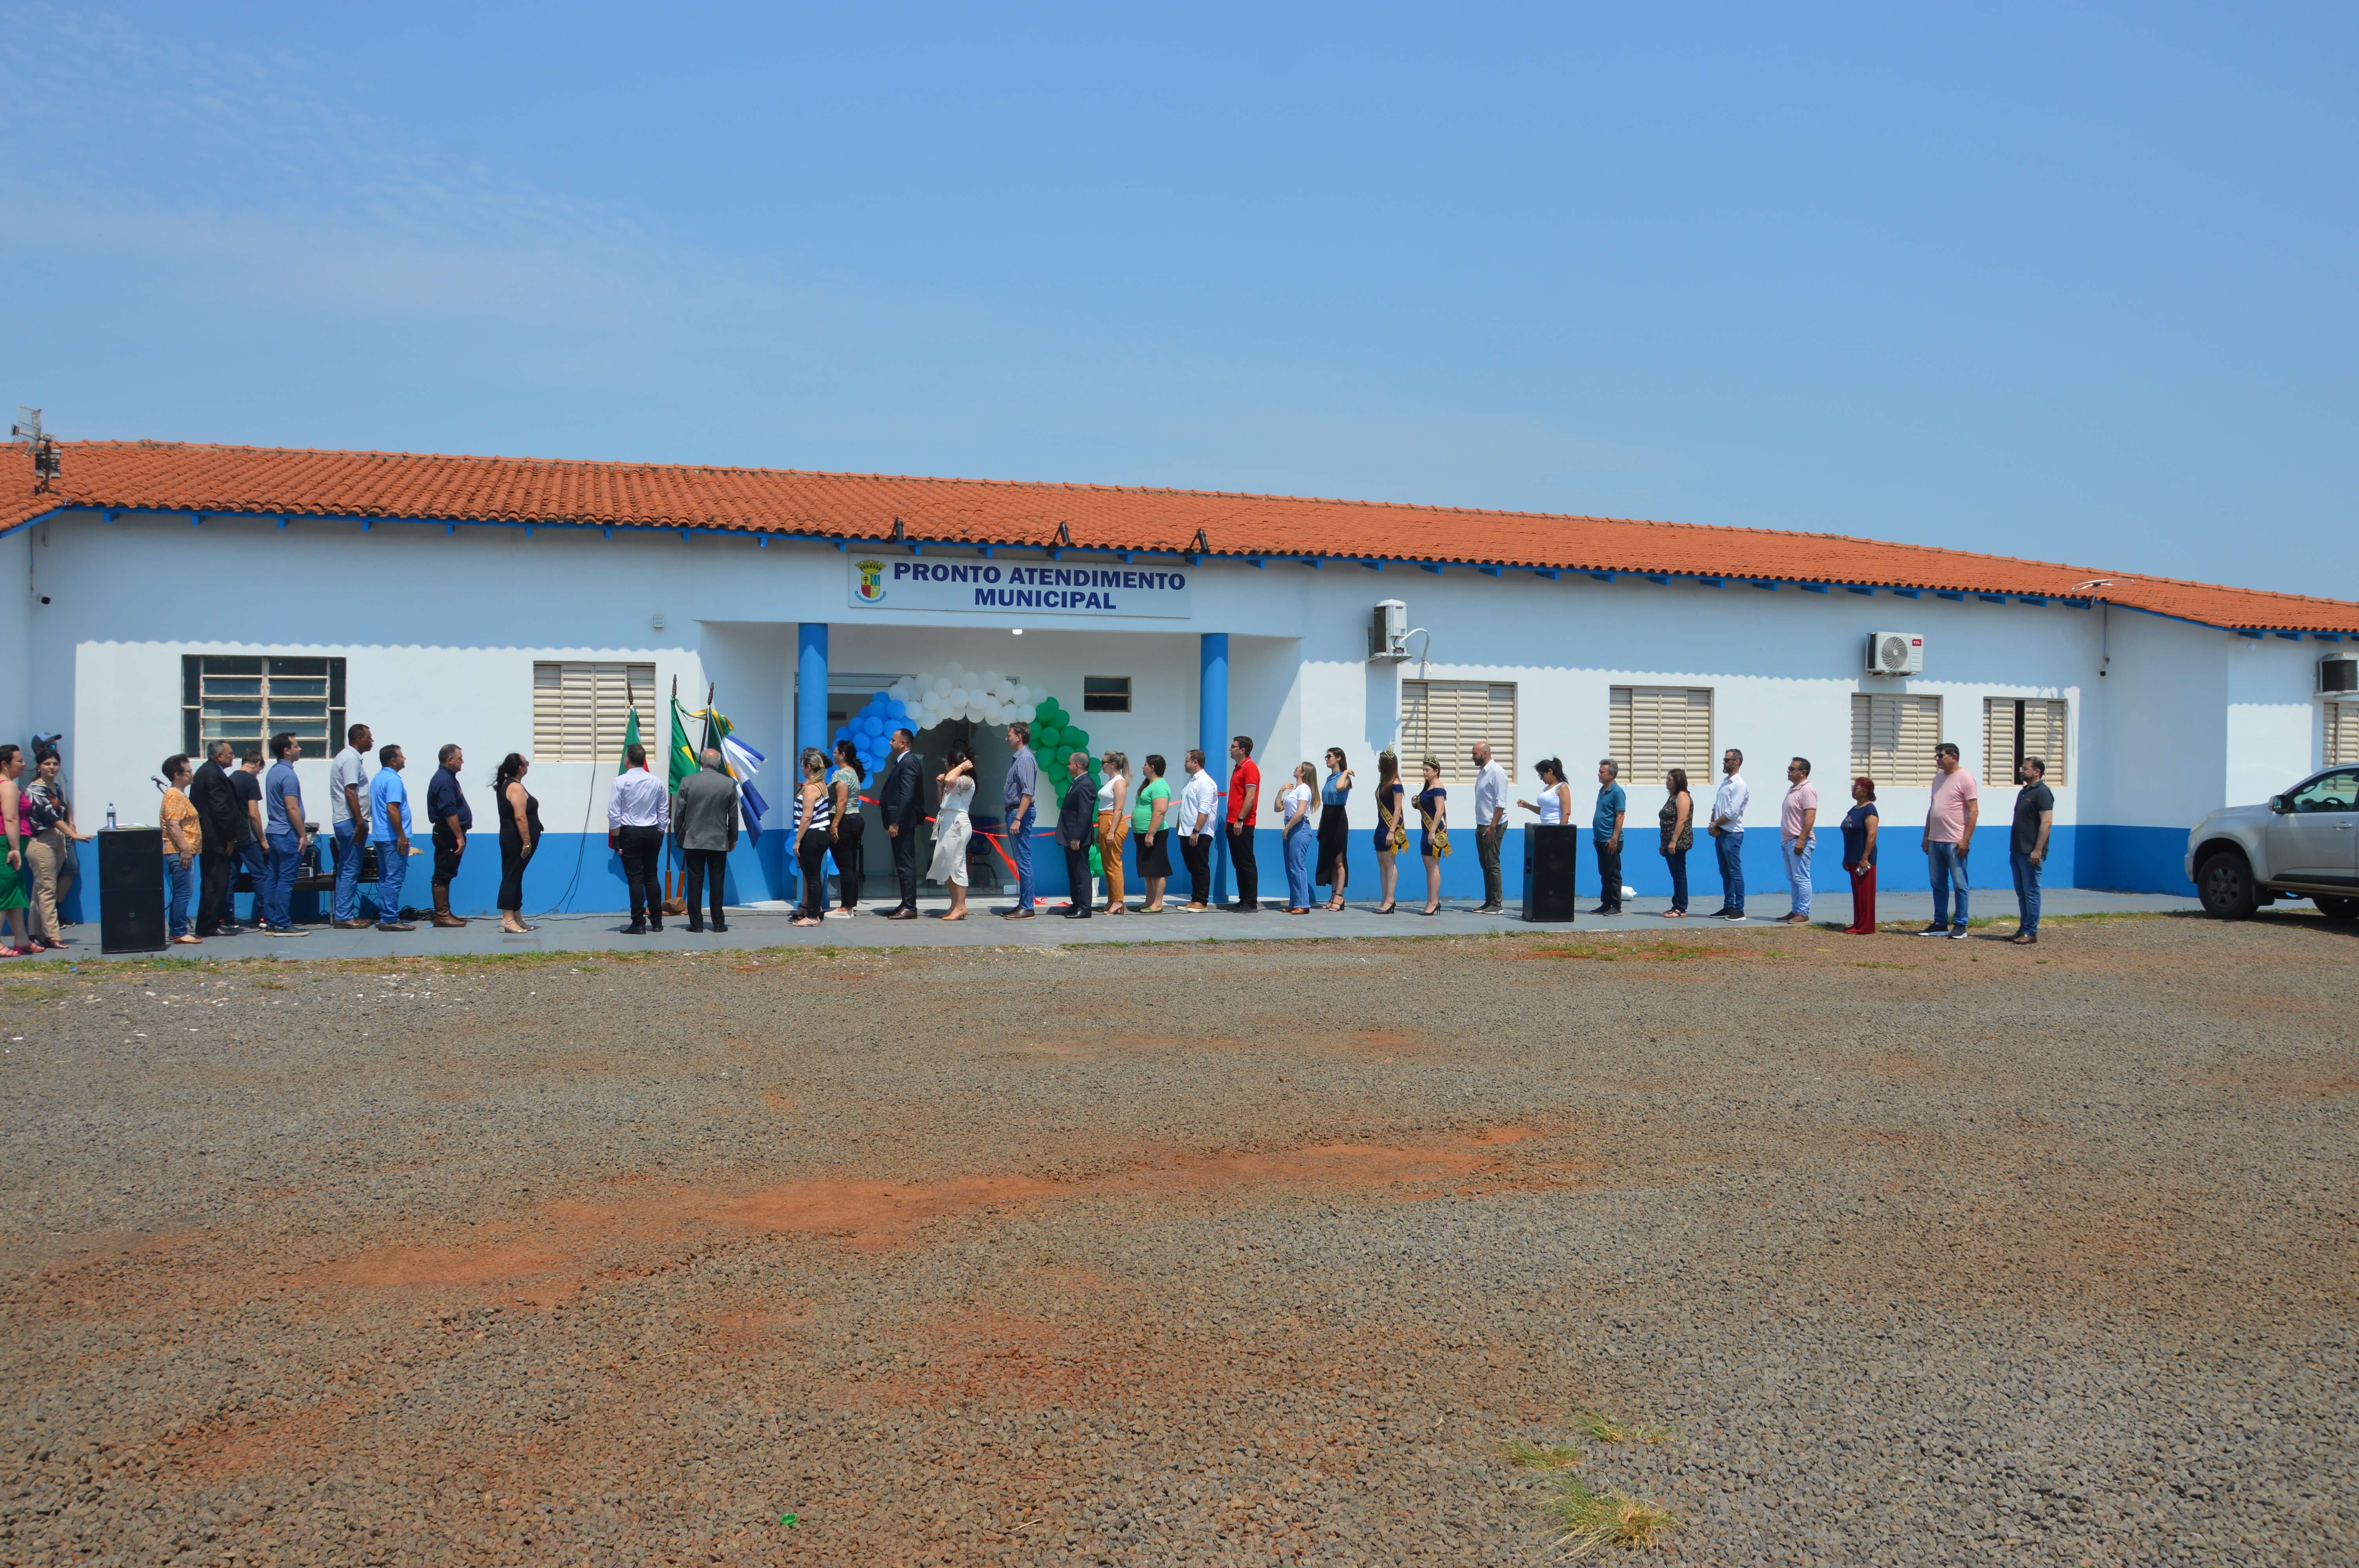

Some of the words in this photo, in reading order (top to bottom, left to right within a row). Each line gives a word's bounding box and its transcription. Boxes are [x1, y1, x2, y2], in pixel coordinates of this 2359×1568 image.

[894, 562, 1001, 584] PRONTO
[1008, 567, 1186, 590] ATENDIMENTO
[974, 588, 1117, 610] MUNICIPAL
